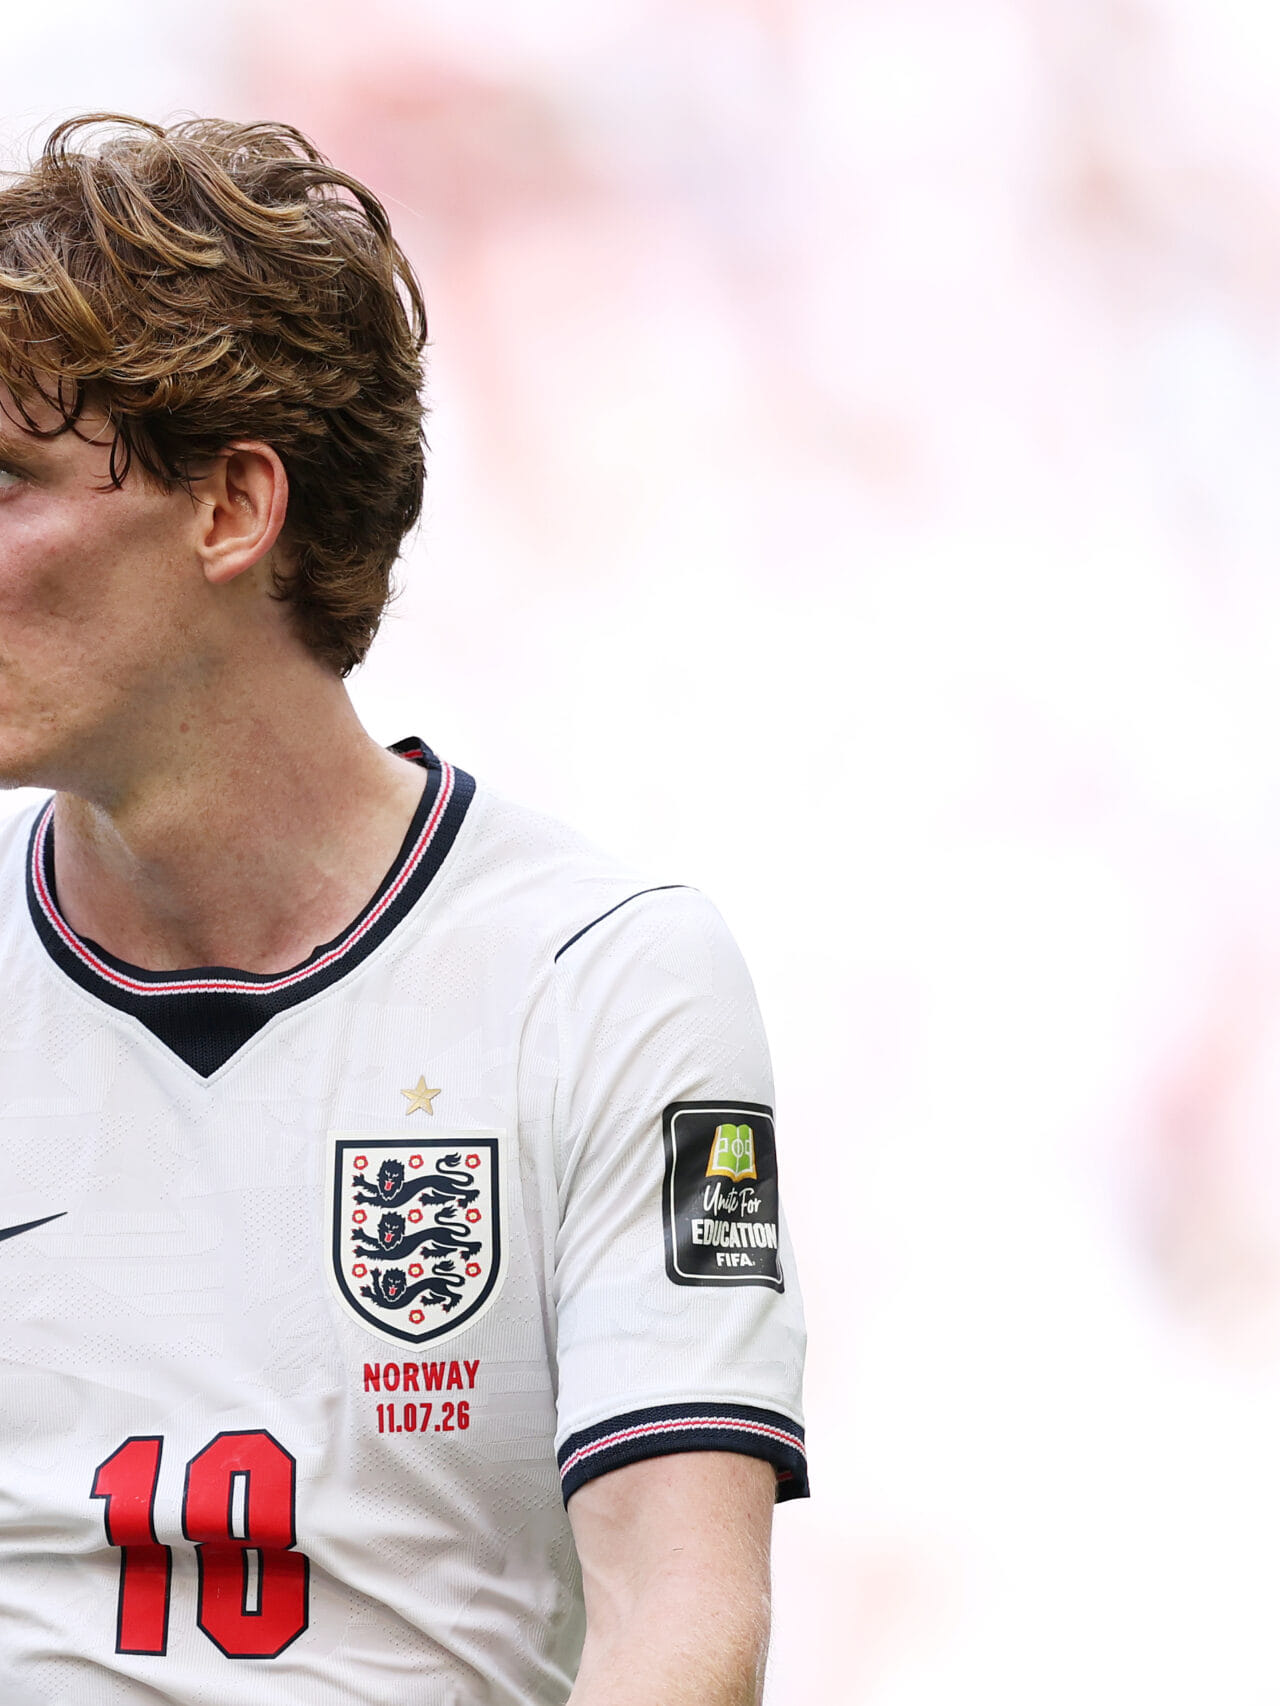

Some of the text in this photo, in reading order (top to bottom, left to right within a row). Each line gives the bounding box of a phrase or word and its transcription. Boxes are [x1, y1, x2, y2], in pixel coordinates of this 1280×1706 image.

[703, 1182, 762, 1217] Unite For
[691, 1219, 778, 1249] EDUCATION
[363, 1360, 480, 1392] NORWAY
[376, 1401, 470, 1433] 11.07.26
[89, 1429, 310, 1659] 18
